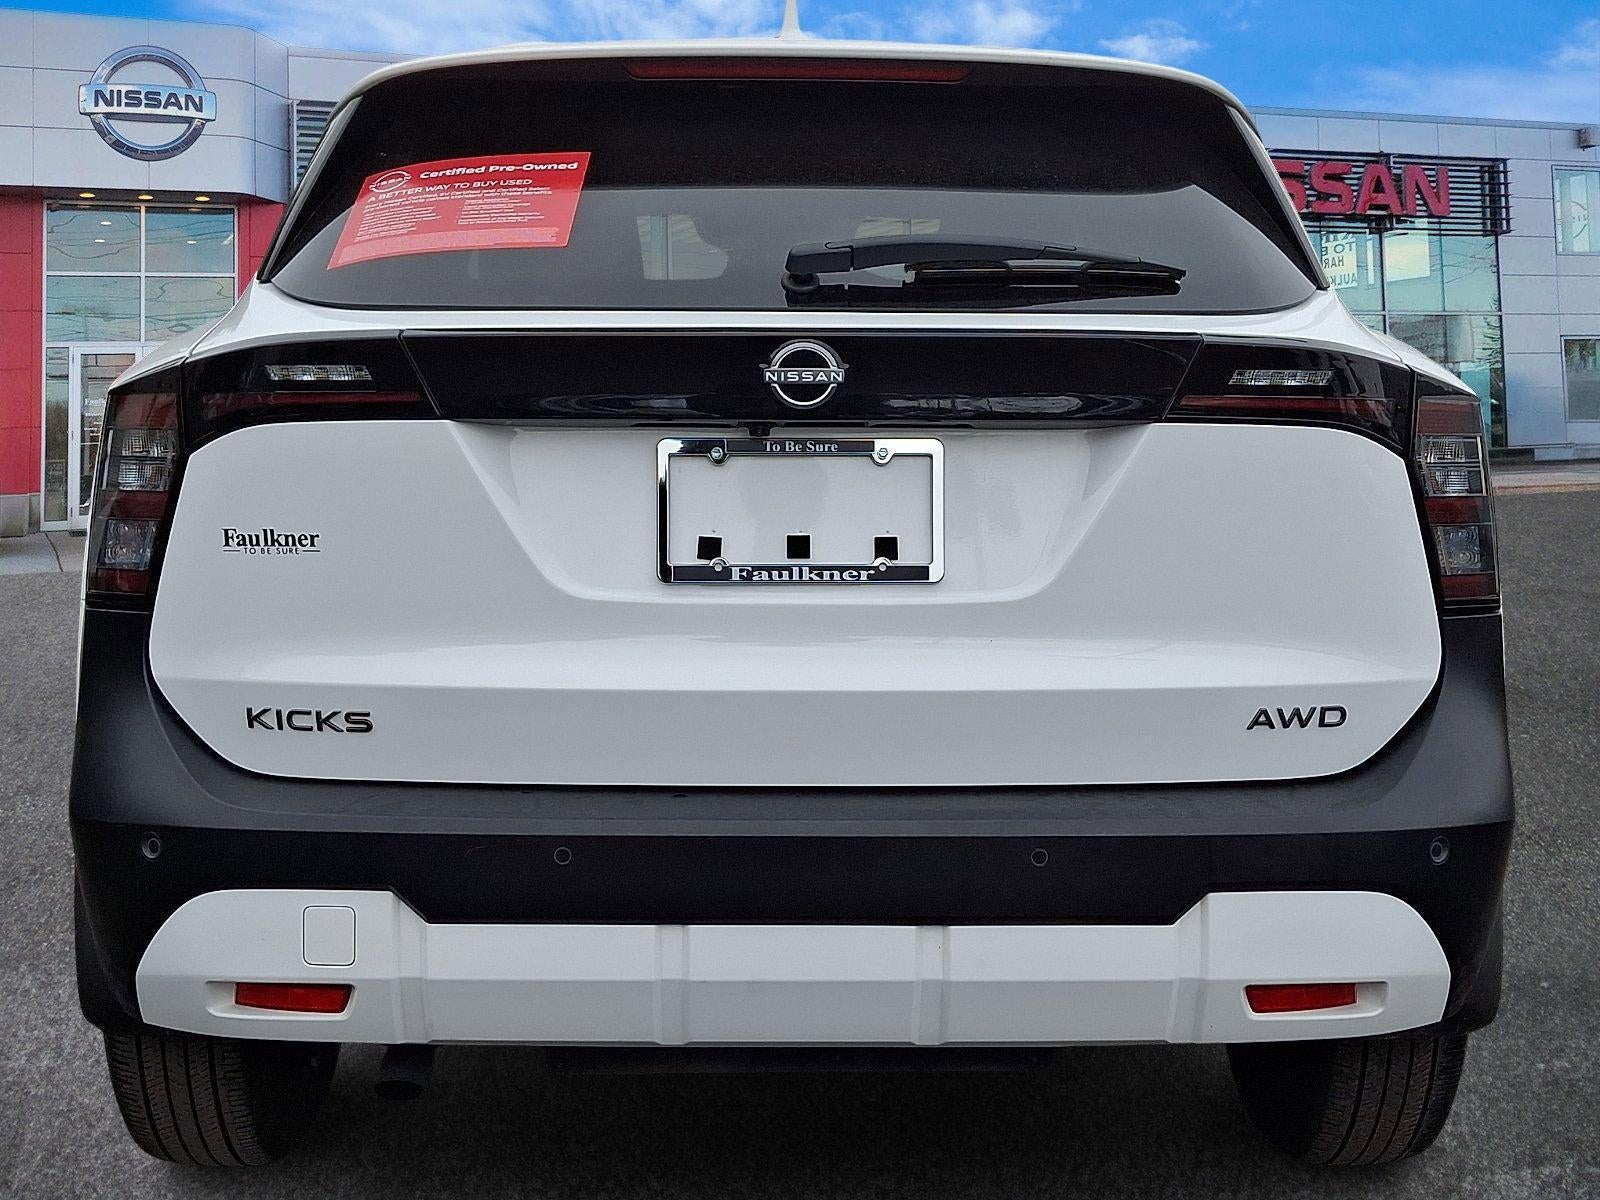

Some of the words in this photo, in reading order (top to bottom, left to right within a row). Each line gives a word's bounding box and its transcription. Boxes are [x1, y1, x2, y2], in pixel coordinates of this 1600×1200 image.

[93, 89, 203, 113] NISSAN
[420, 166, 486, 179] Certified
[488, 161, 579, 173] Pre-Owned
[378, 187, 423, 200] BETTER
[425, 183, 452, 192] WAY
[454, 181, 470, 189] TO
[472, 180, 498, 188] BUY
[499, 178, 533, 186] USED
[1272, 159, 1451, 216] SSAN
[765, 371, 843, 382] NISSAN
[762, 440, 781, 452] To
[785, 440, 802, 452] Be
[806, 440, 839, 452] Sure
[221, 528, 320, 548] Faulkner
[243, 547, 257, 555] TO
[260, 547, 272, 555] BE
[276, 547, 300, 555] SURE
[729, 566, 876, 581] Faulkner
[246, 707, 374, 733] KICKS
[1246, 706, 1348, 731] AWD
